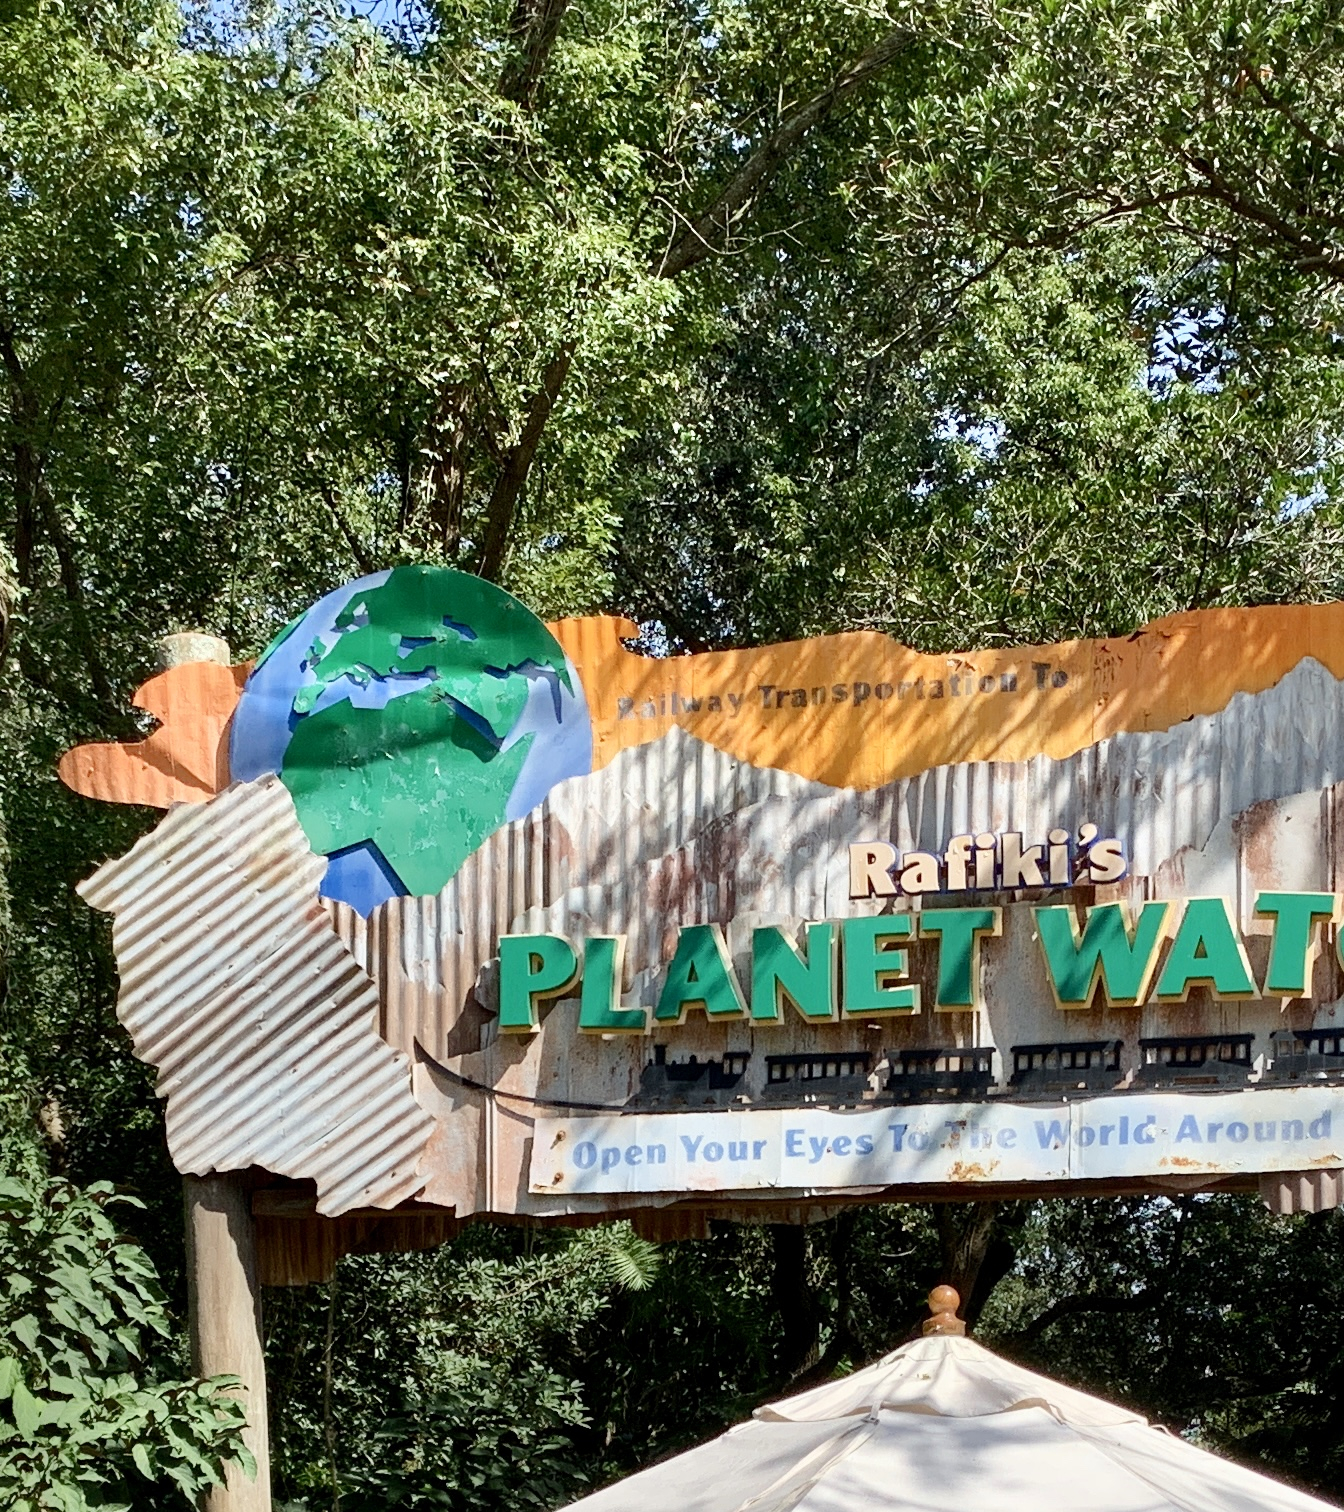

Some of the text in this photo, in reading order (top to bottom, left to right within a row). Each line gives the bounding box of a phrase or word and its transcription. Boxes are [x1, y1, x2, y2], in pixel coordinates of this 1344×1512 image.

[618, 661, 1068, 720] Railway Transportation To
[848, 823, 1128, 899] Rafiki's
[498, 906, 1003, 1035] PLANET
[572, 1139, 666, 1174] Open
[680, 1133, 767, 1164] Your
[785, 1127, 873, 1165] Eyes
[889, 1123, 930, 1153] To
[944, 1120, 1017, 1152] The
[1035, 1115, 1156, 1151] World
[1175, 1109, 1332, 1144] Around
